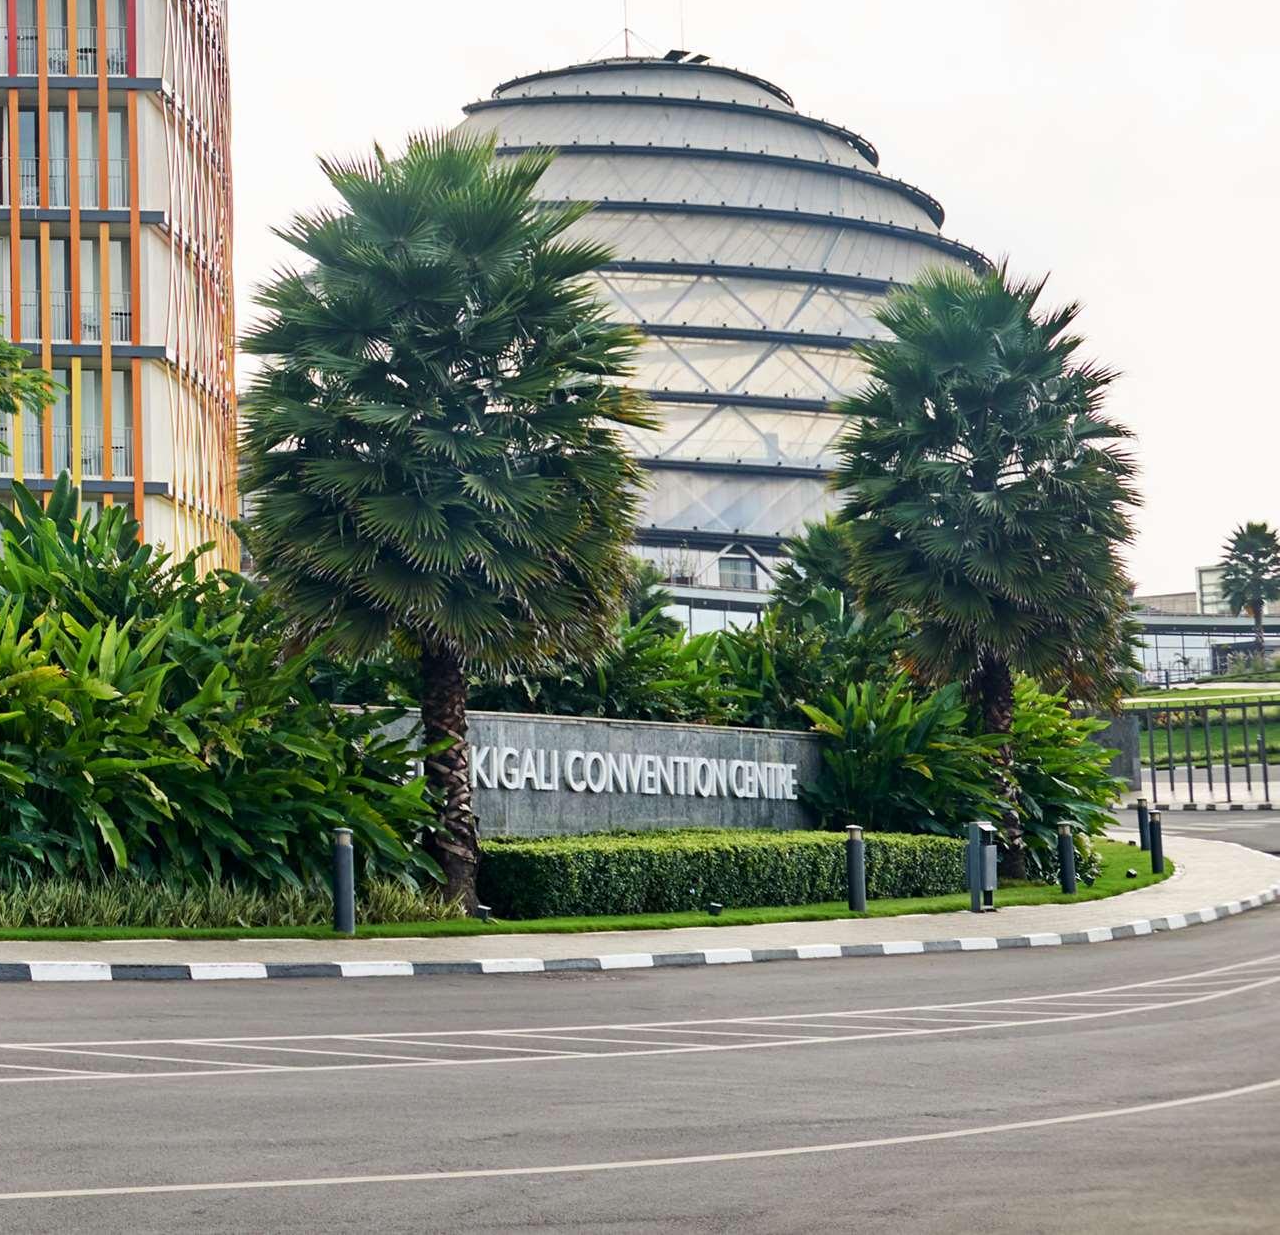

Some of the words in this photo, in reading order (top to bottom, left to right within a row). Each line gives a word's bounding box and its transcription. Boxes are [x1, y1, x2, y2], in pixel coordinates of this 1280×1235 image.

[470, 745, 559, 791] KIGALI
[564, 750, 728, 798] CONVENTION
[728, 759, 799, 801] CENTRE
